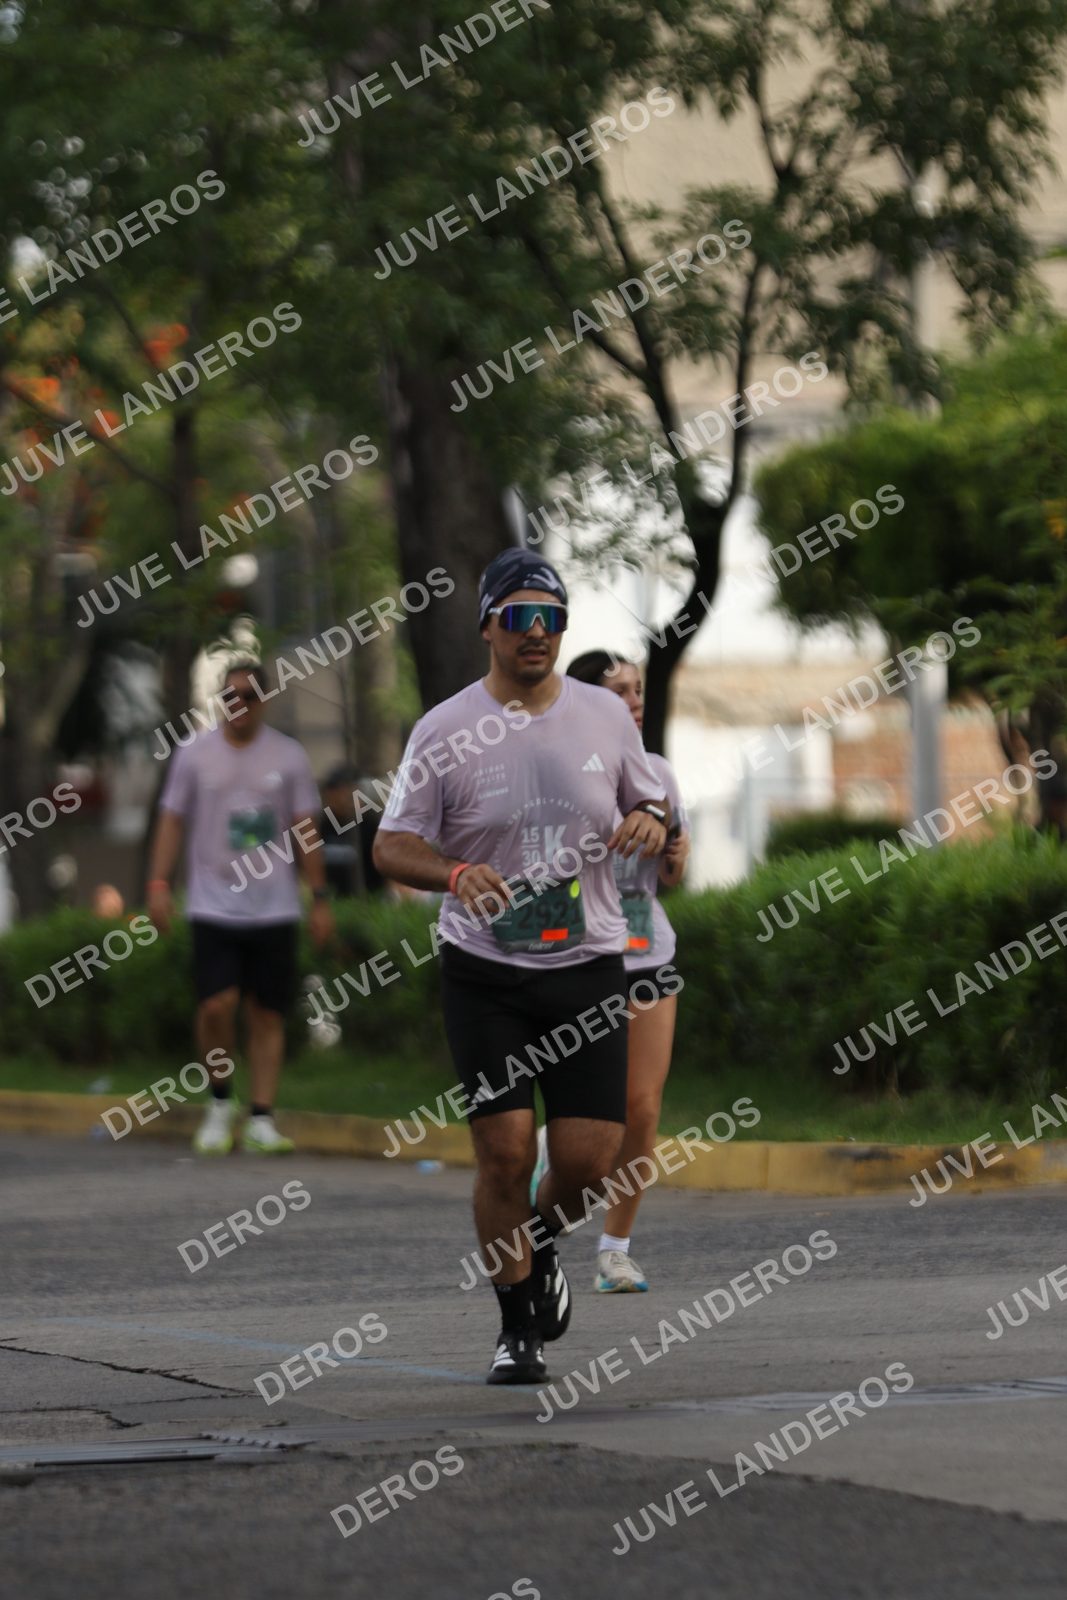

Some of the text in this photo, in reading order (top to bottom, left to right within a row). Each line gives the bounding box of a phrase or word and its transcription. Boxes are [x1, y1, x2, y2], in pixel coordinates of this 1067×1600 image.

[521, 826, 541, 844] 15
[544, 824, 568, 865] K
[521, 849, 542, 868] 30
[517, 901, 582, 929] 2921
